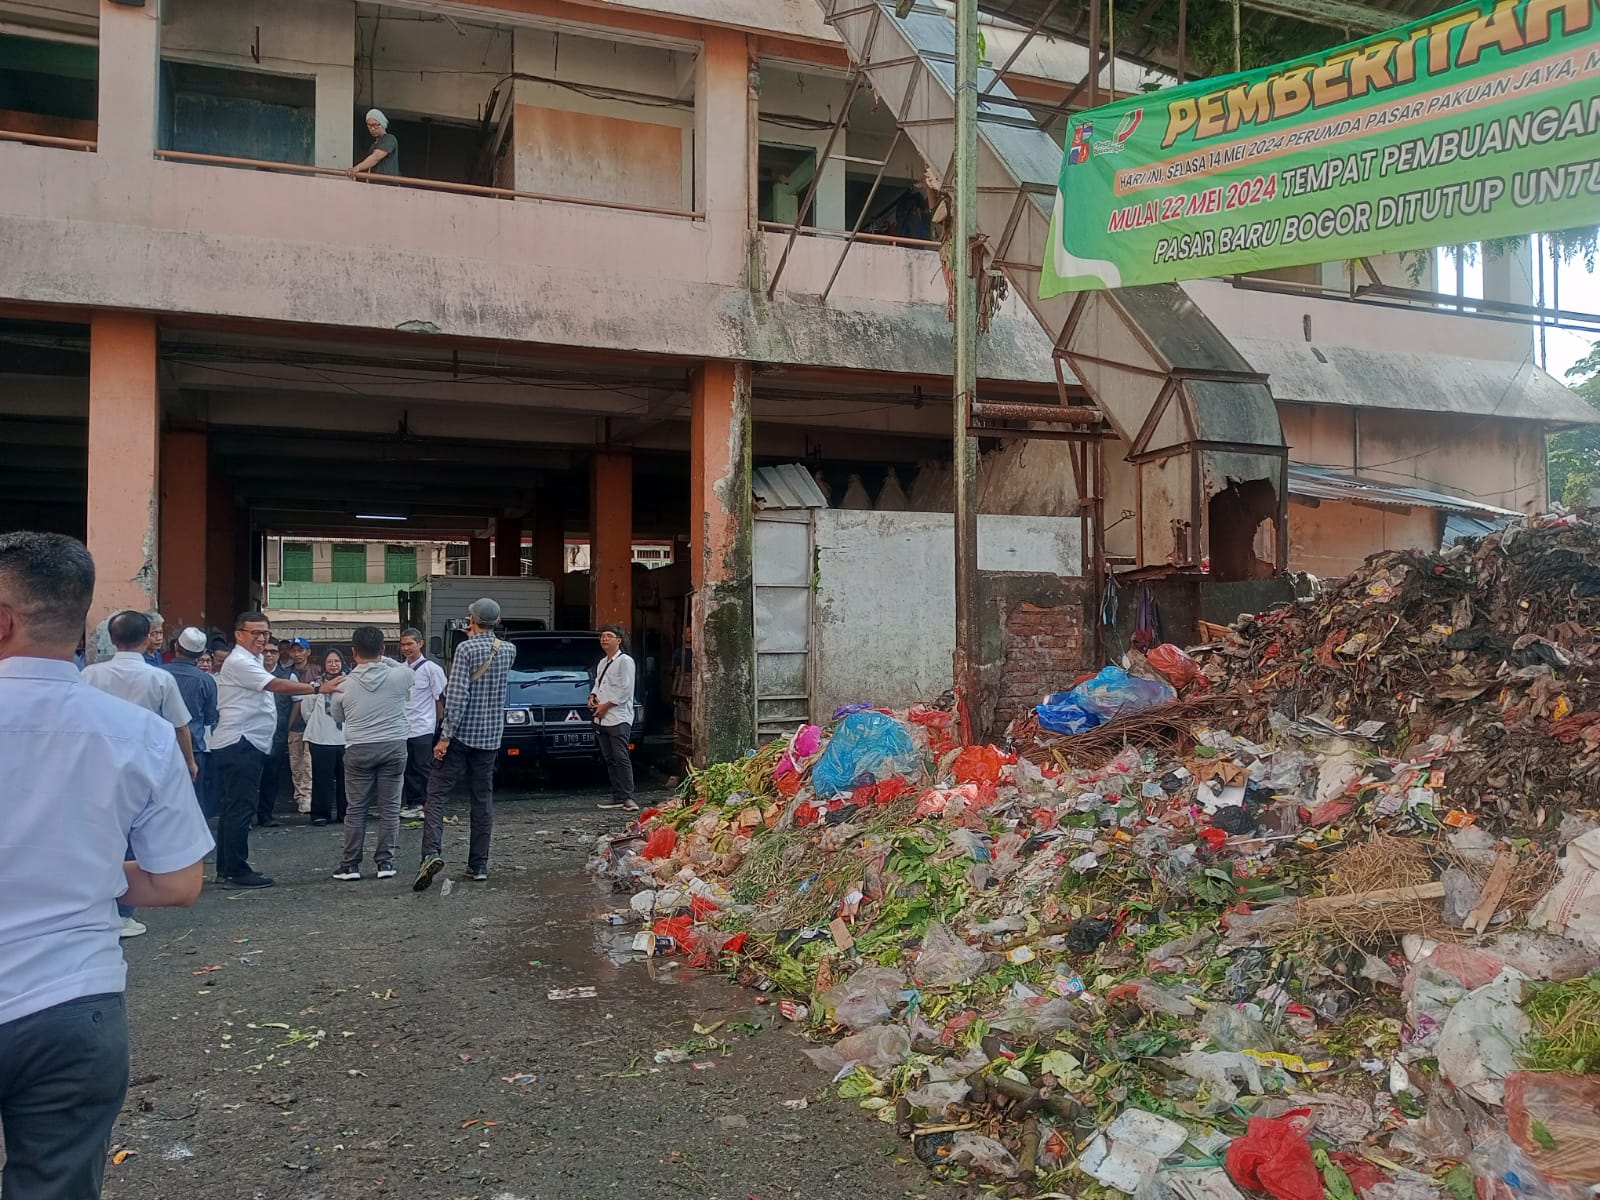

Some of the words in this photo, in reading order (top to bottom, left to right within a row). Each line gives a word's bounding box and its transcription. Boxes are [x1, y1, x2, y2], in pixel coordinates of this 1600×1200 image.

[1120, 171, 1149, 189] HARI
[1147, 169, 1164, 185] INI,
[1167, 158, 1206, 179] SELASA
[1209, 151, 1221, 168] 14
[1224, 146, 1245, 164] MEI
[1248, 137, 1287, 157] 2024
[1286, 118, 1361, 147] PERUMDA
[1365, 102, 1424, 129] PASAR
[1427, 77, 1511, 113] PAKUAN
[1513, 59, 1577, 90] JAYA,
[1161, 0, 1600, 148] PEMBERITAH
[1108, 200, 1159, 231] MULAI
[1161, 196, 1186, 221] 22
[1186, 189, 1222, 215] MEI
[1226, 175, 1276, 209] 2024
[1282, 148, 1378, 198] TEMPAT
[1153, 229, 1215, 264] PASAR
[1219, 218, 1281, 254] BARU
[1280, 201, 1372, 245] BOGOR
[1376, 175, 1505, 230] DITUTUP
